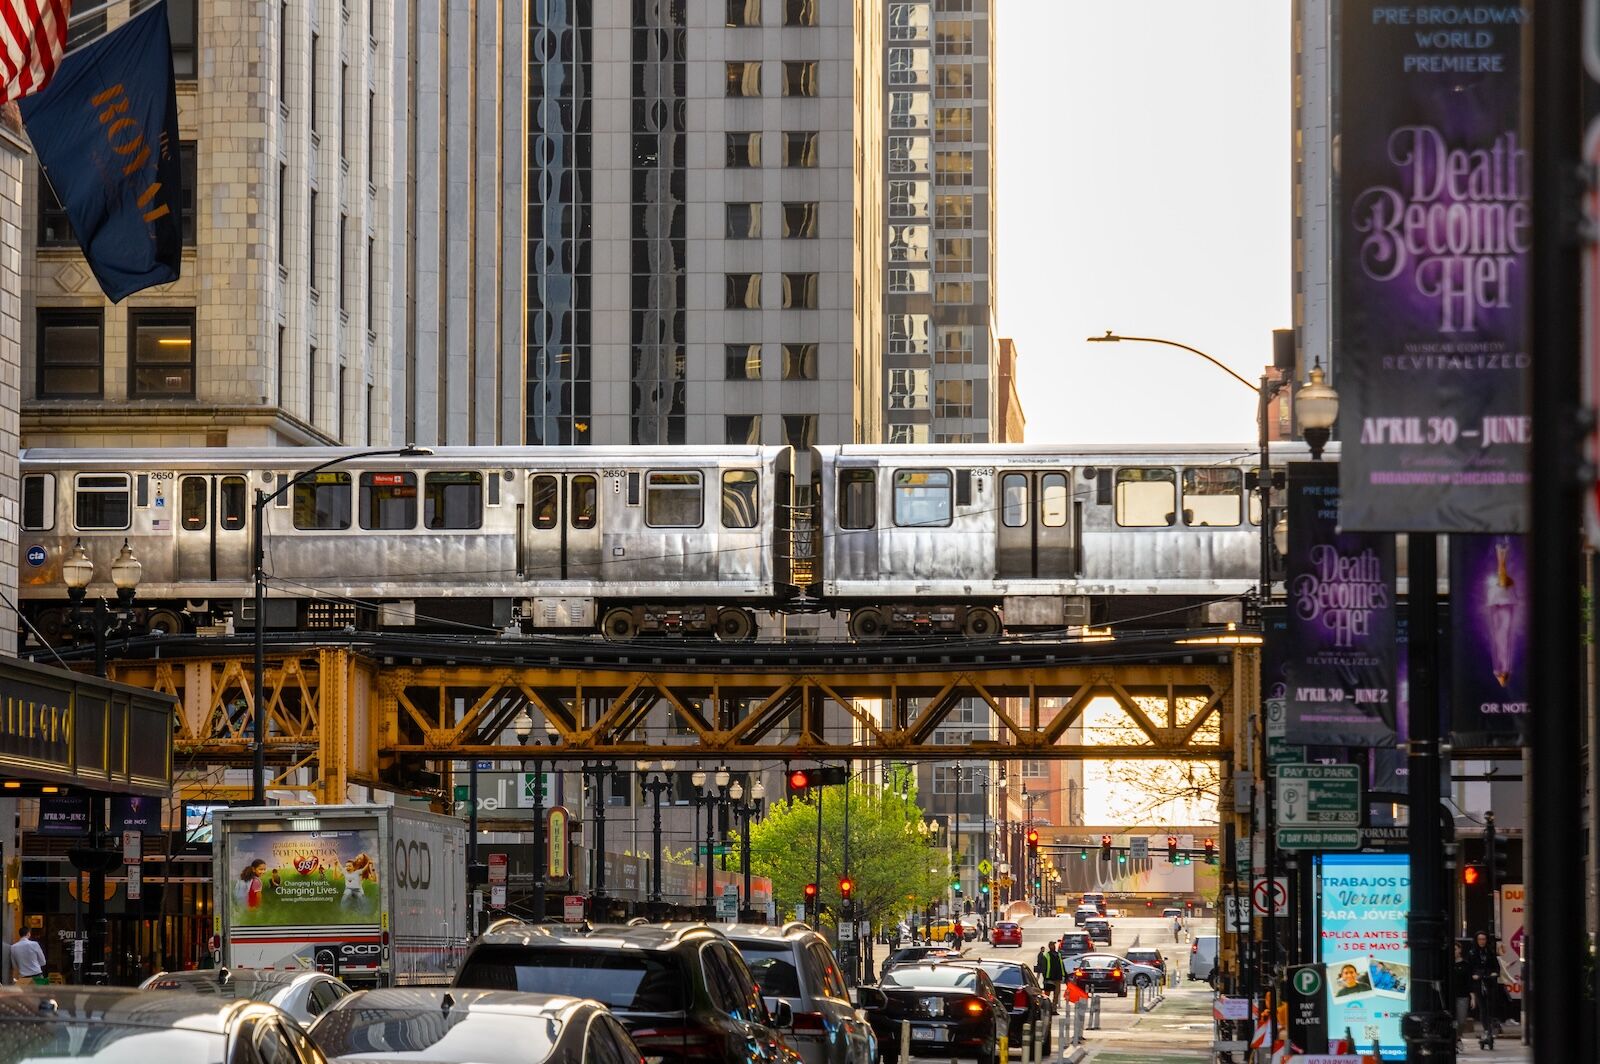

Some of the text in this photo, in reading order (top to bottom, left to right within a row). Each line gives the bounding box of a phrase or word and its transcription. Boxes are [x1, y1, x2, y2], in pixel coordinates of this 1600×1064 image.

[1372, 9, 1531, 24] PRE-BROADWAY
[1415, 32, 1493, 48] WORLD
[1404, 56, 1504, 72] PREMIERE
[1415, 255, 1516, 332] Her
[1383, 354, 1531, 369] REVITALIZED
[1361, 417, 1424, 444] APRIL
[1428, 416, 1457, 444] 30
[1481, 415, 1532, 447] JUNE
[971, 468, 993, 476] 2649
[29, 552, 44, 560] cta
[1311, 544, 1381, 583] Death
[1292, 573, 1388, 621] Becomes
[1323, 609, 1373, 647] Her
[1306, 656, 1379, 666] REVITALIZED
[1296, 687, 1327, 702] APRIL
[1328, 688, 1345, 702] 30
[1354, 688, 1378, 704] JUNE
[1379, 689, 1389, 702] 2
[1480, 703, 1500, 713] OR
[0, 693, 70, 745] LLEGRO
[1283, 768, 1353, 777] PAY TO PARK
[1396, 768, 1408, 776] OR
[1286, 833, 1302, 842] DAY
[1303, 833, 1321, 842] PAID
[1323, 833, 1357, 842] PARKING
[553, 819, 561, 874] THEATRE
[298, 857, 318, 871] gsf
[395, 838, 431, 892] QCD
[284, 880, 311, 888] Changing
[1322, 877, 1396, 887] TRABAJOS
[275, 886, 339, 896] Changing Lives.
[1338, 890, 1403, 907] Verano
[1321, 931, 1360, 939] APLICA
[1363, 931, 1399, 939] ANTES
[341, 945, 381, 955] QCD
[1369, 943, 1400, 951] MAYO
[1301, 973, 1313, 991] P
[1300, 1002, 1314, 1010] PAY
